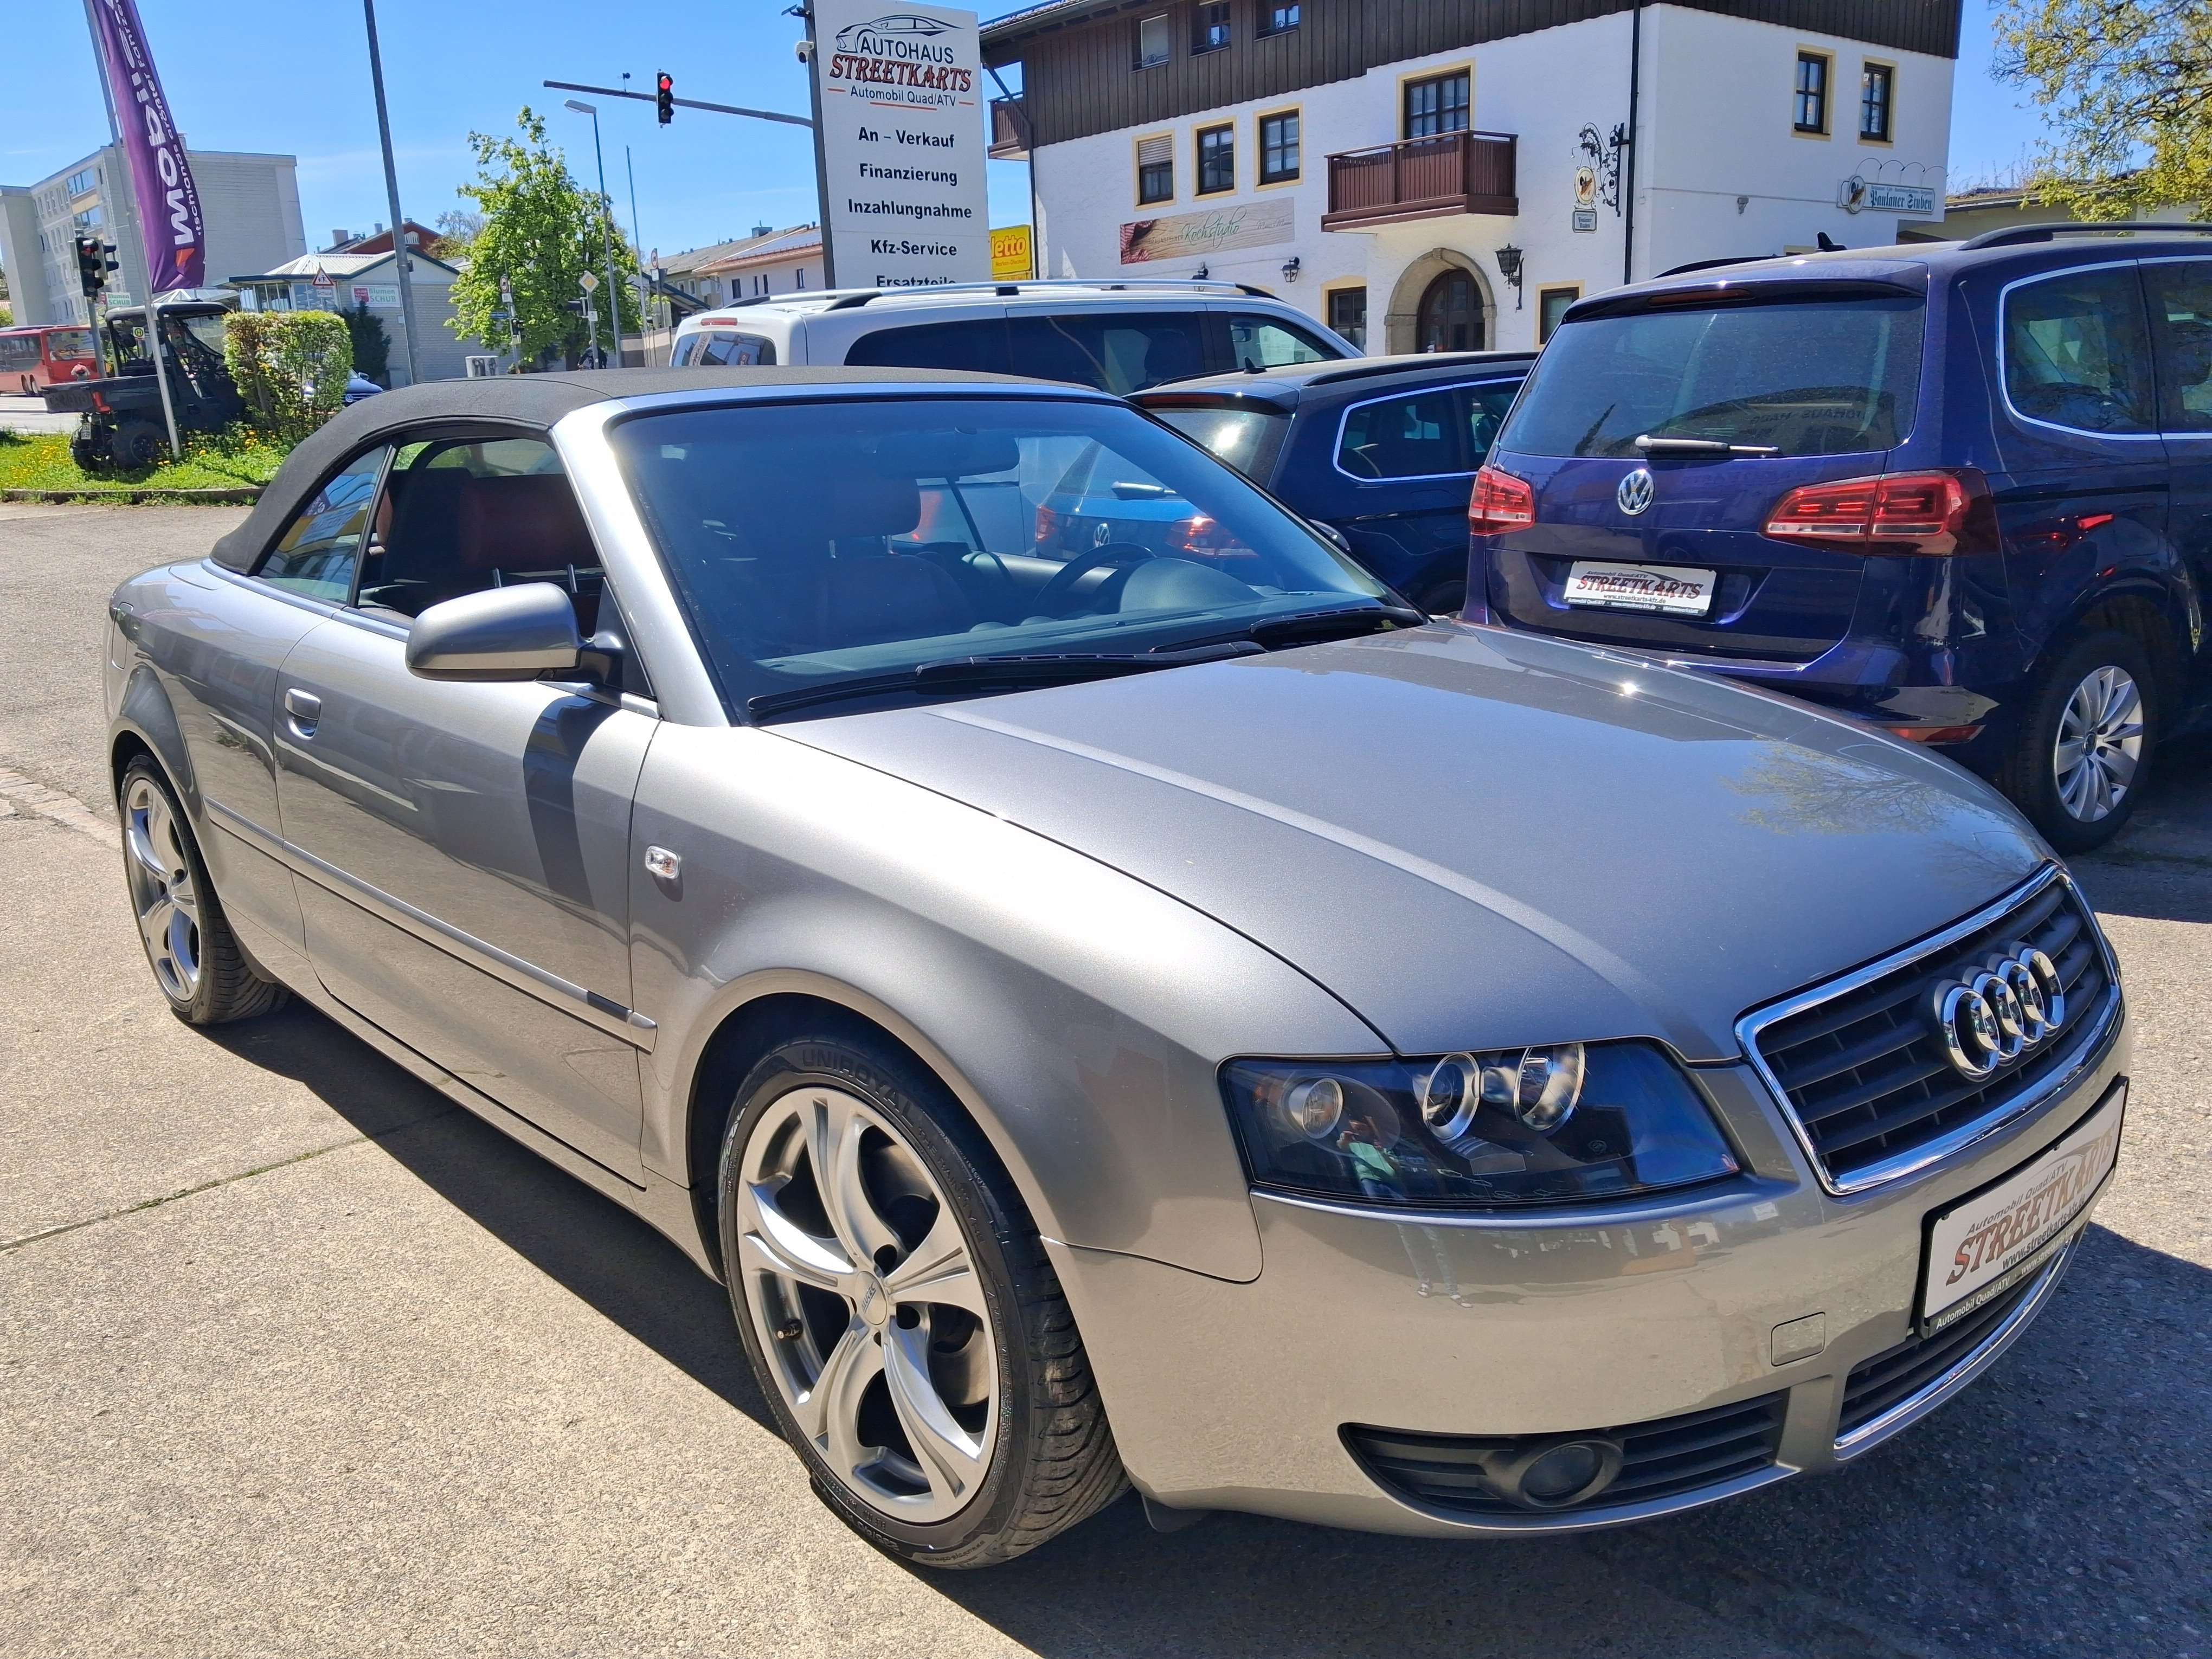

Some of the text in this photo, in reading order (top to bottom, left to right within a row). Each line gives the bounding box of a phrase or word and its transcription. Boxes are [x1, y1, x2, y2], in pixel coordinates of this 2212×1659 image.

[115, 0, 146, 67] Fahrze
[860, 36, 954, 64] AUTOHAUS
[829, 53, 972, 92] STREETKARTS
[850, 85, 956, 107] Automobil Quad/ATV
[858, 126, 879, 142] An
[895, 129, 955, 148] Verkauf
[859, 163, 957, 187] Finanzierung
[848, 198, 972, 220] Inzahlungnahme
[1870, 190, 1932, 210] Paulaner Stuben
[1182, 205, 1247, 249] Kochstudio
[871, 239, 957, 256] Kfz-Service
[1576, 575, 1703, 599] STREETKARTS
[802, 1048, 914, 1128] UNIROYAL
[1966, 1160, 2068, 1236] Automobil Quad/ATV
[1935, 1297, 1975, 1330] Automobil
[1976, 1276, 2011, 1310] Quad/ATV
